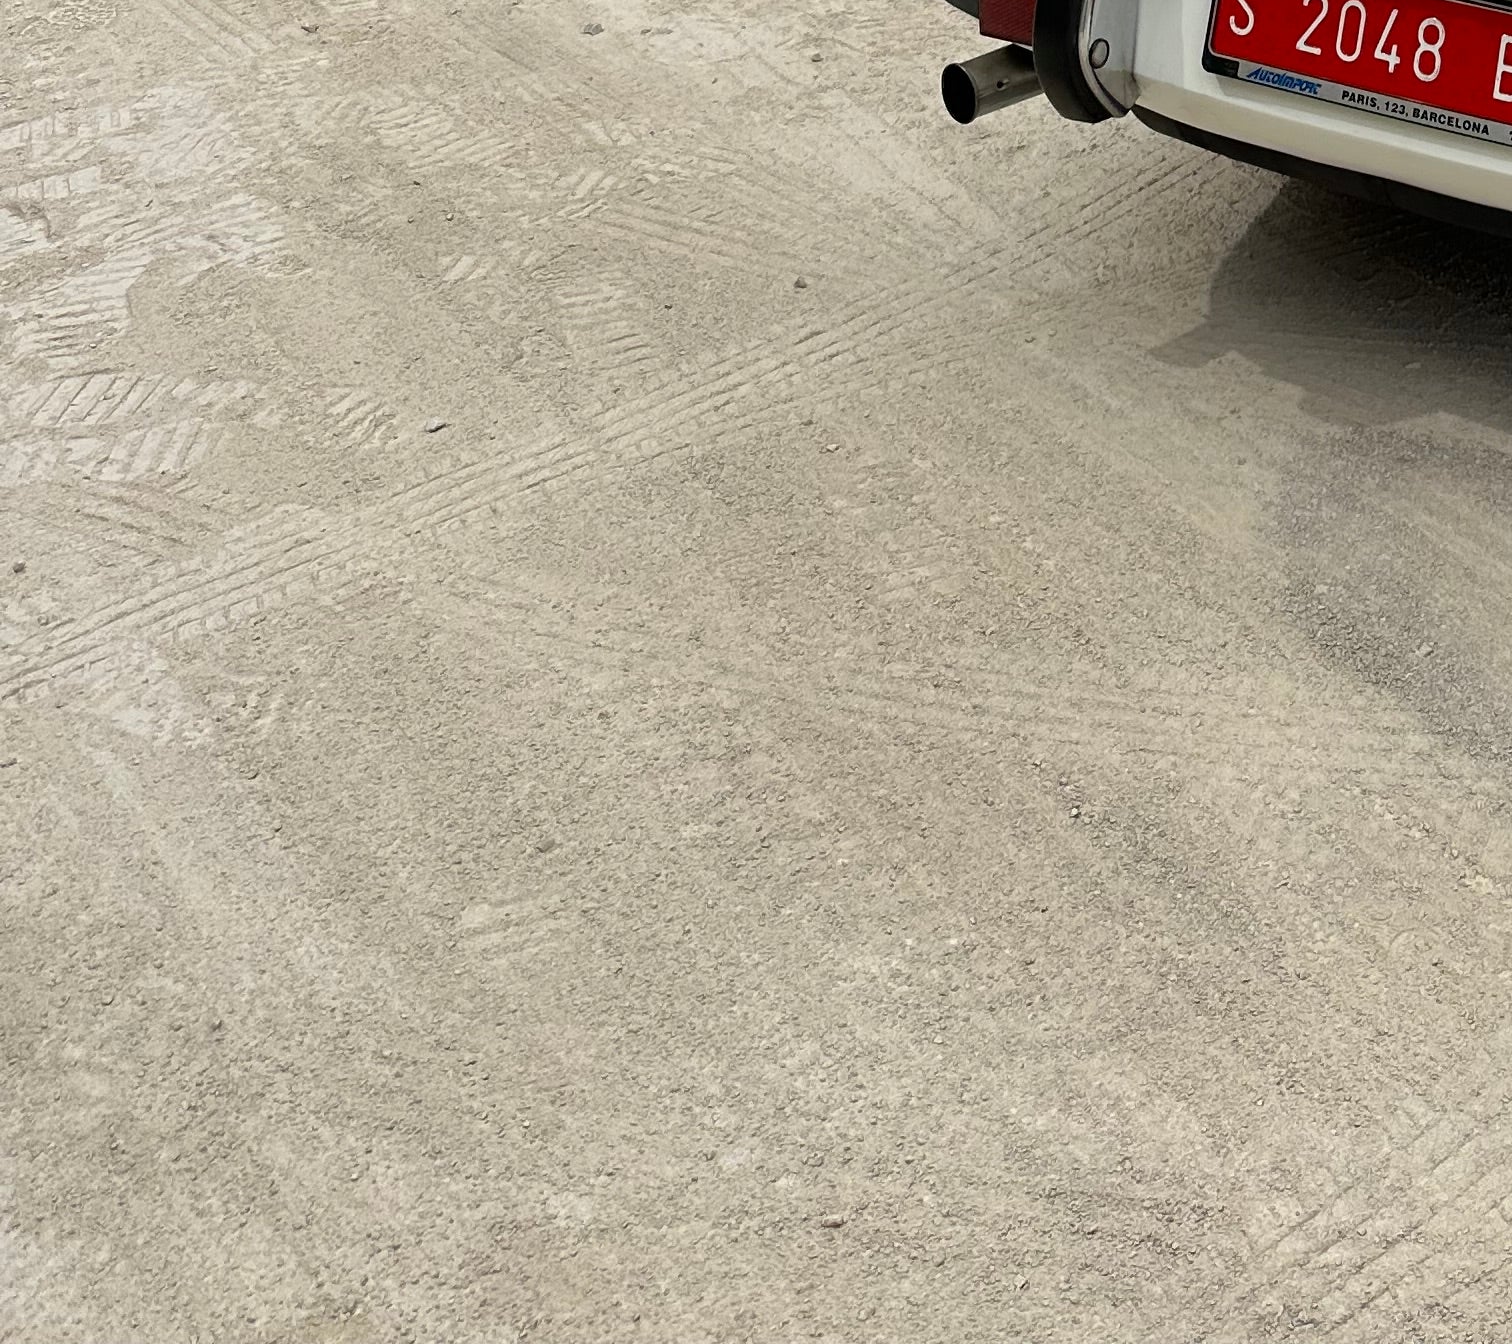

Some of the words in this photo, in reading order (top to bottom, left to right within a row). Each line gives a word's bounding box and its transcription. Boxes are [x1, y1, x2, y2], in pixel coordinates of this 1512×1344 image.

[1341, 90, 1380, 110] PARIS,
[1385, 101, 1409, 118] 123,
[1412, 107, 1490, 136] BARCELONA
